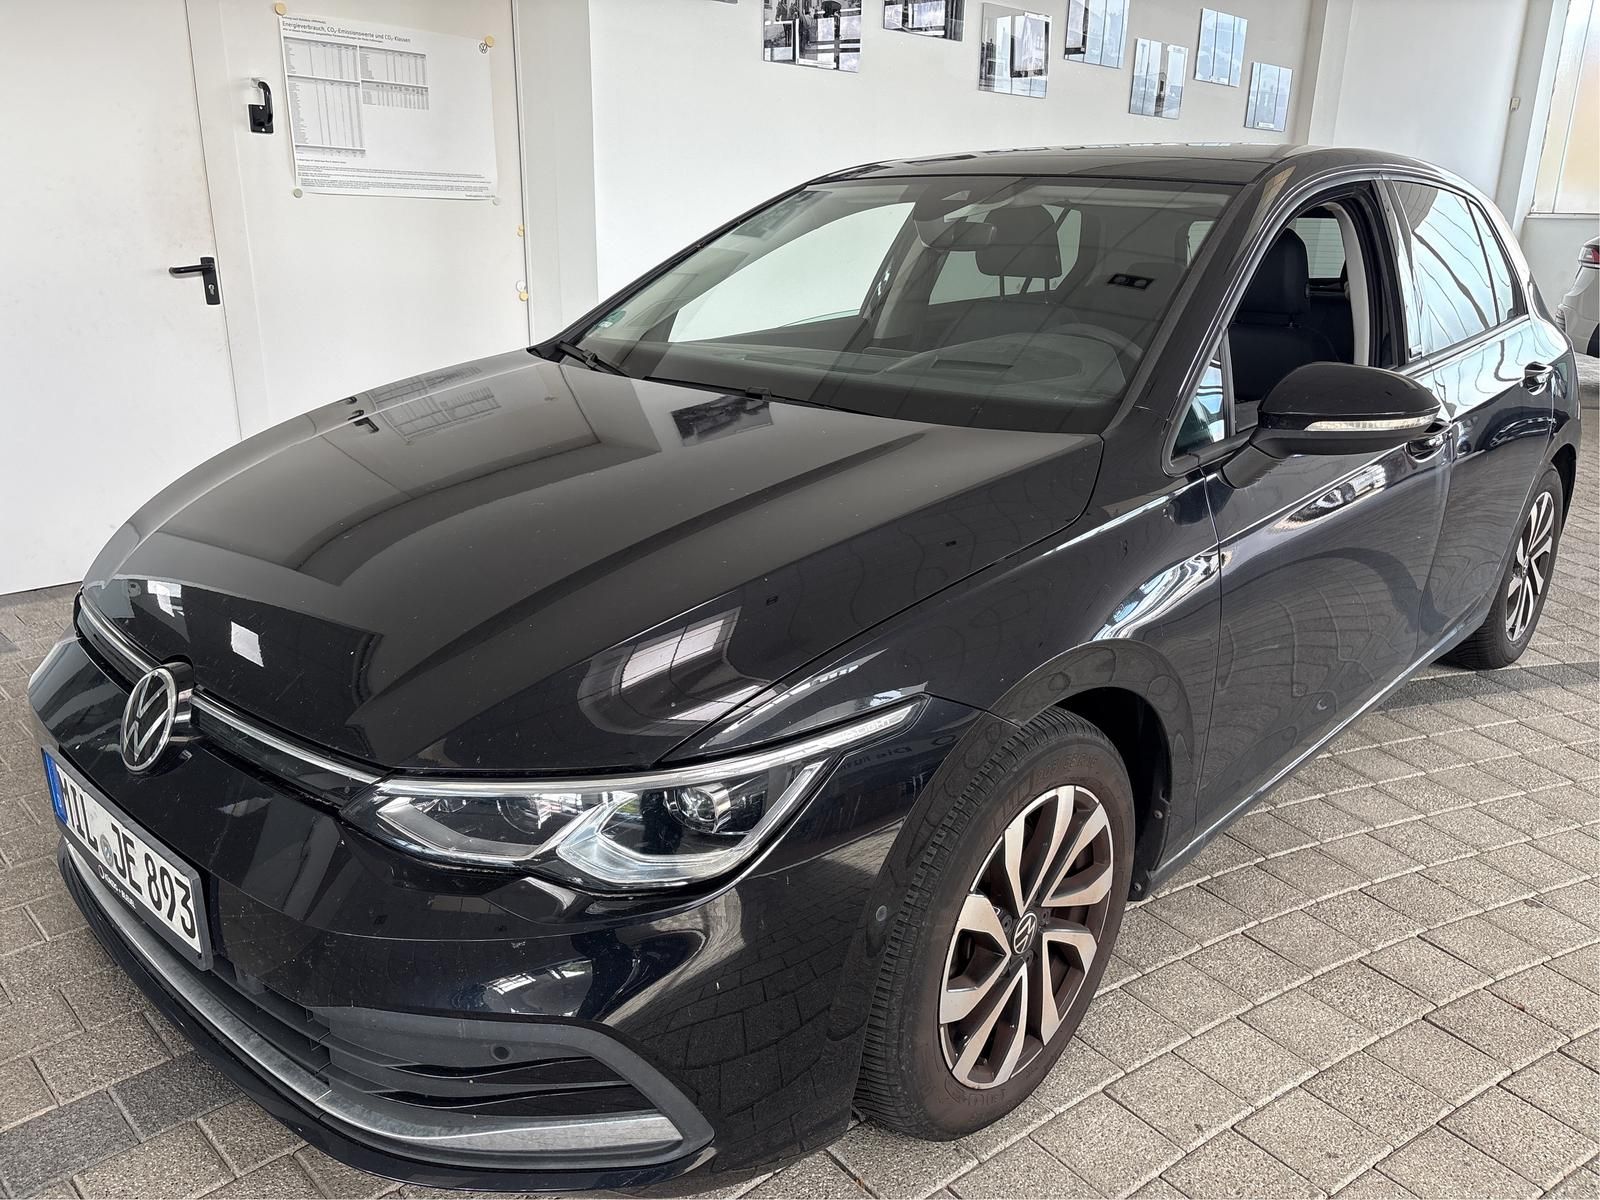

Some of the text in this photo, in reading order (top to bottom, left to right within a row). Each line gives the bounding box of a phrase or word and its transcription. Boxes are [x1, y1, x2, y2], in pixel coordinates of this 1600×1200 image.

[57, 769, 99, 852] MIL
[111, 822, 143, 896] JE
[144, 852, 196, 939] 893
